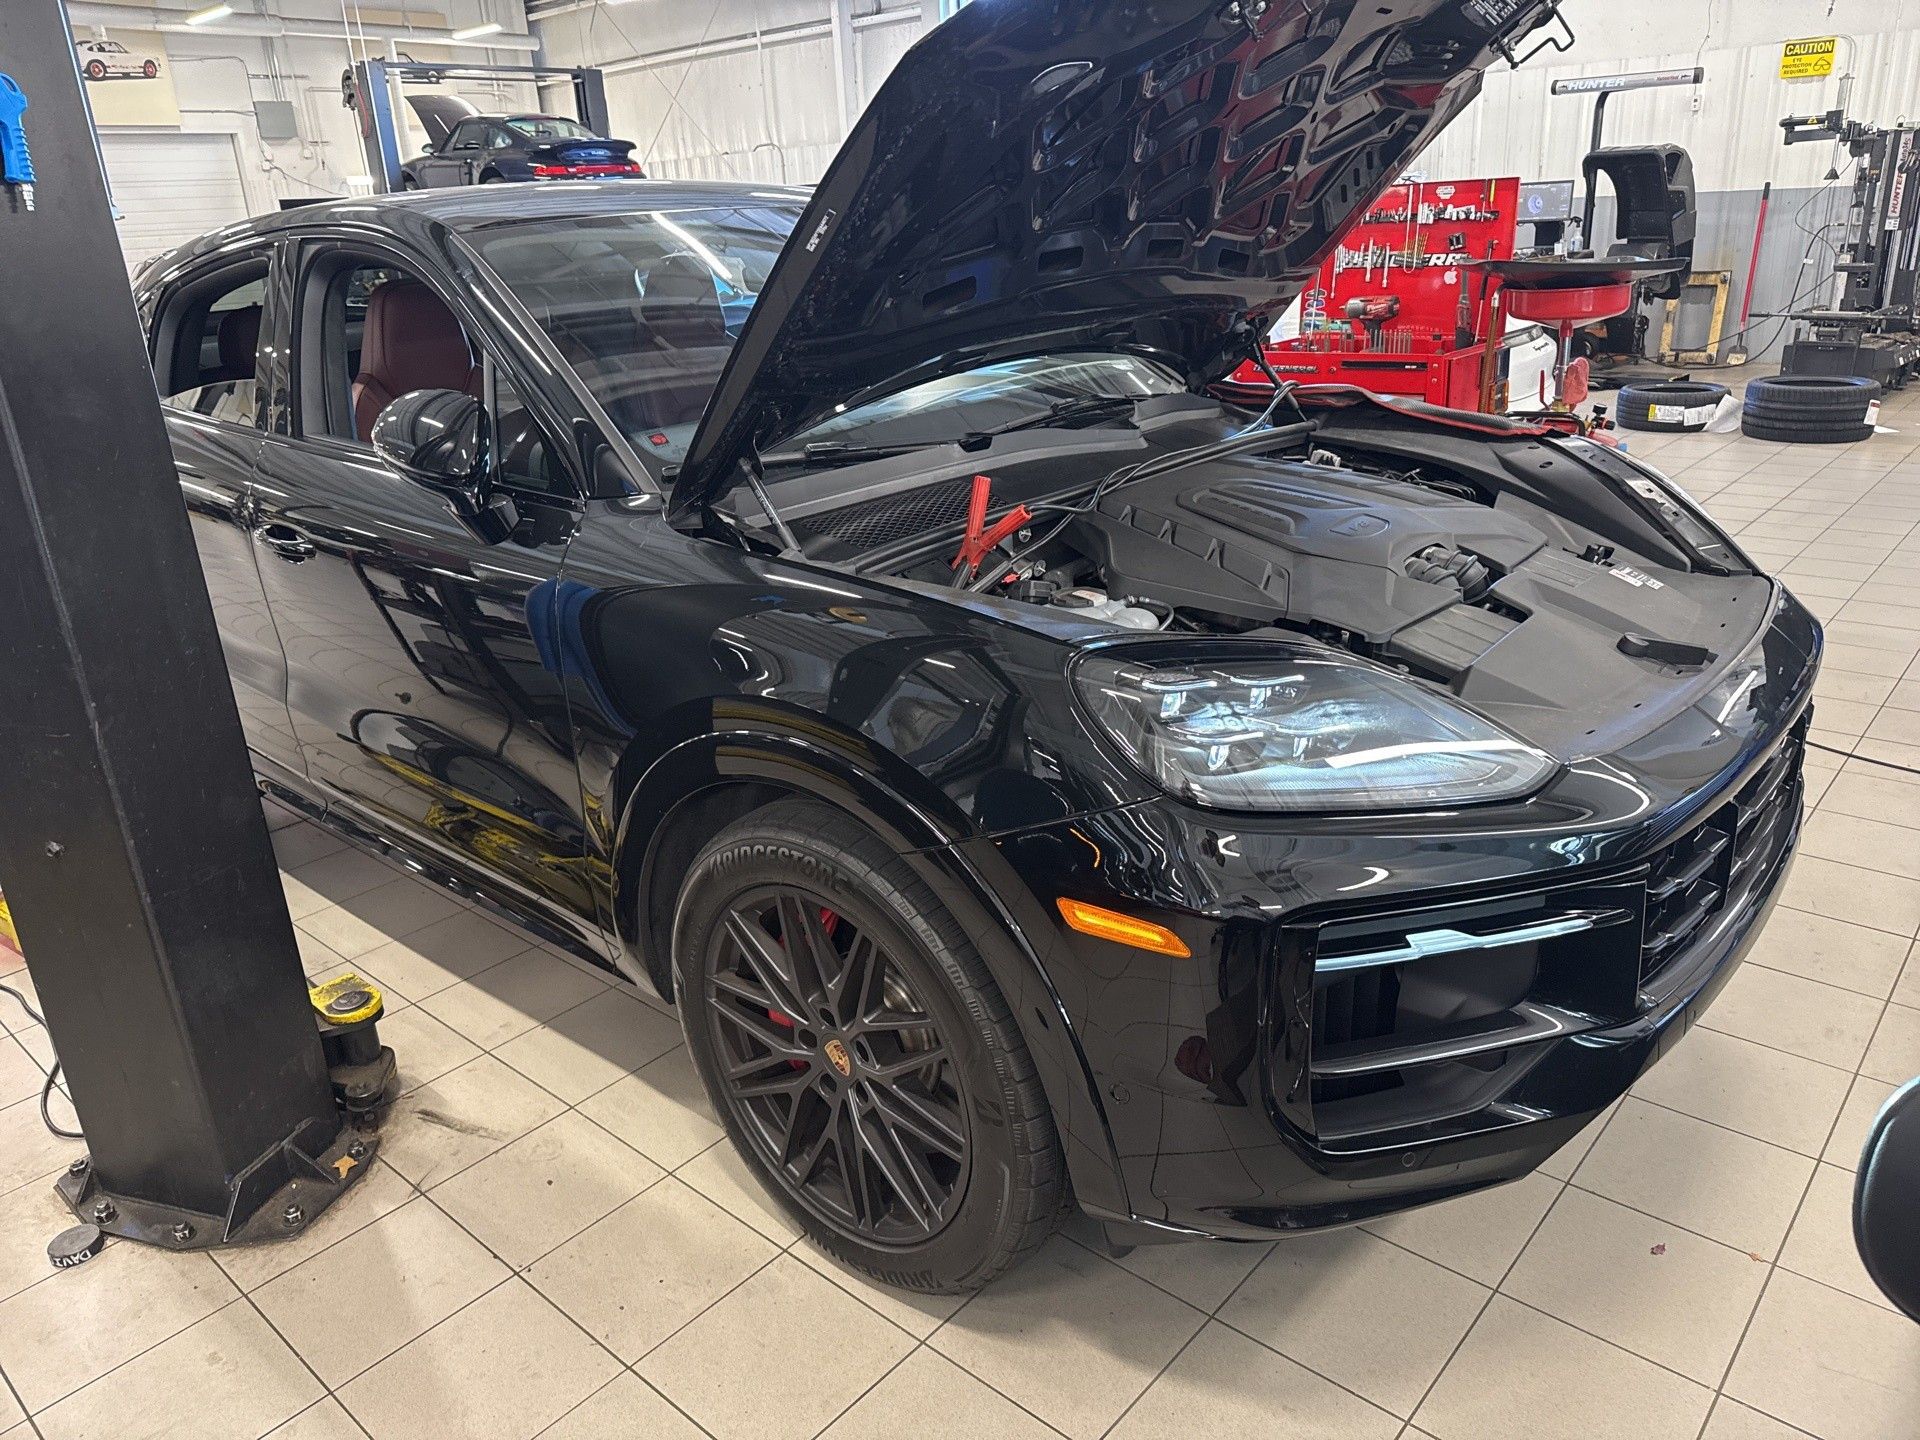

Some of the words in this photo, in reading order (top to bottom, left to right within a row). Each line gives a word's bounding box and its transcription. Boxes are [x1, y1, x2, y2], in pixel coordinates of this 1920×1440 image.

[1786, 41, 1834, 56] CAUTION
[1781, 62, 1813, 70] PROTECTION
[1567, 77, 1626, 91] HUNTER
[709, 844, 852, 894] BRIDGESTONE
